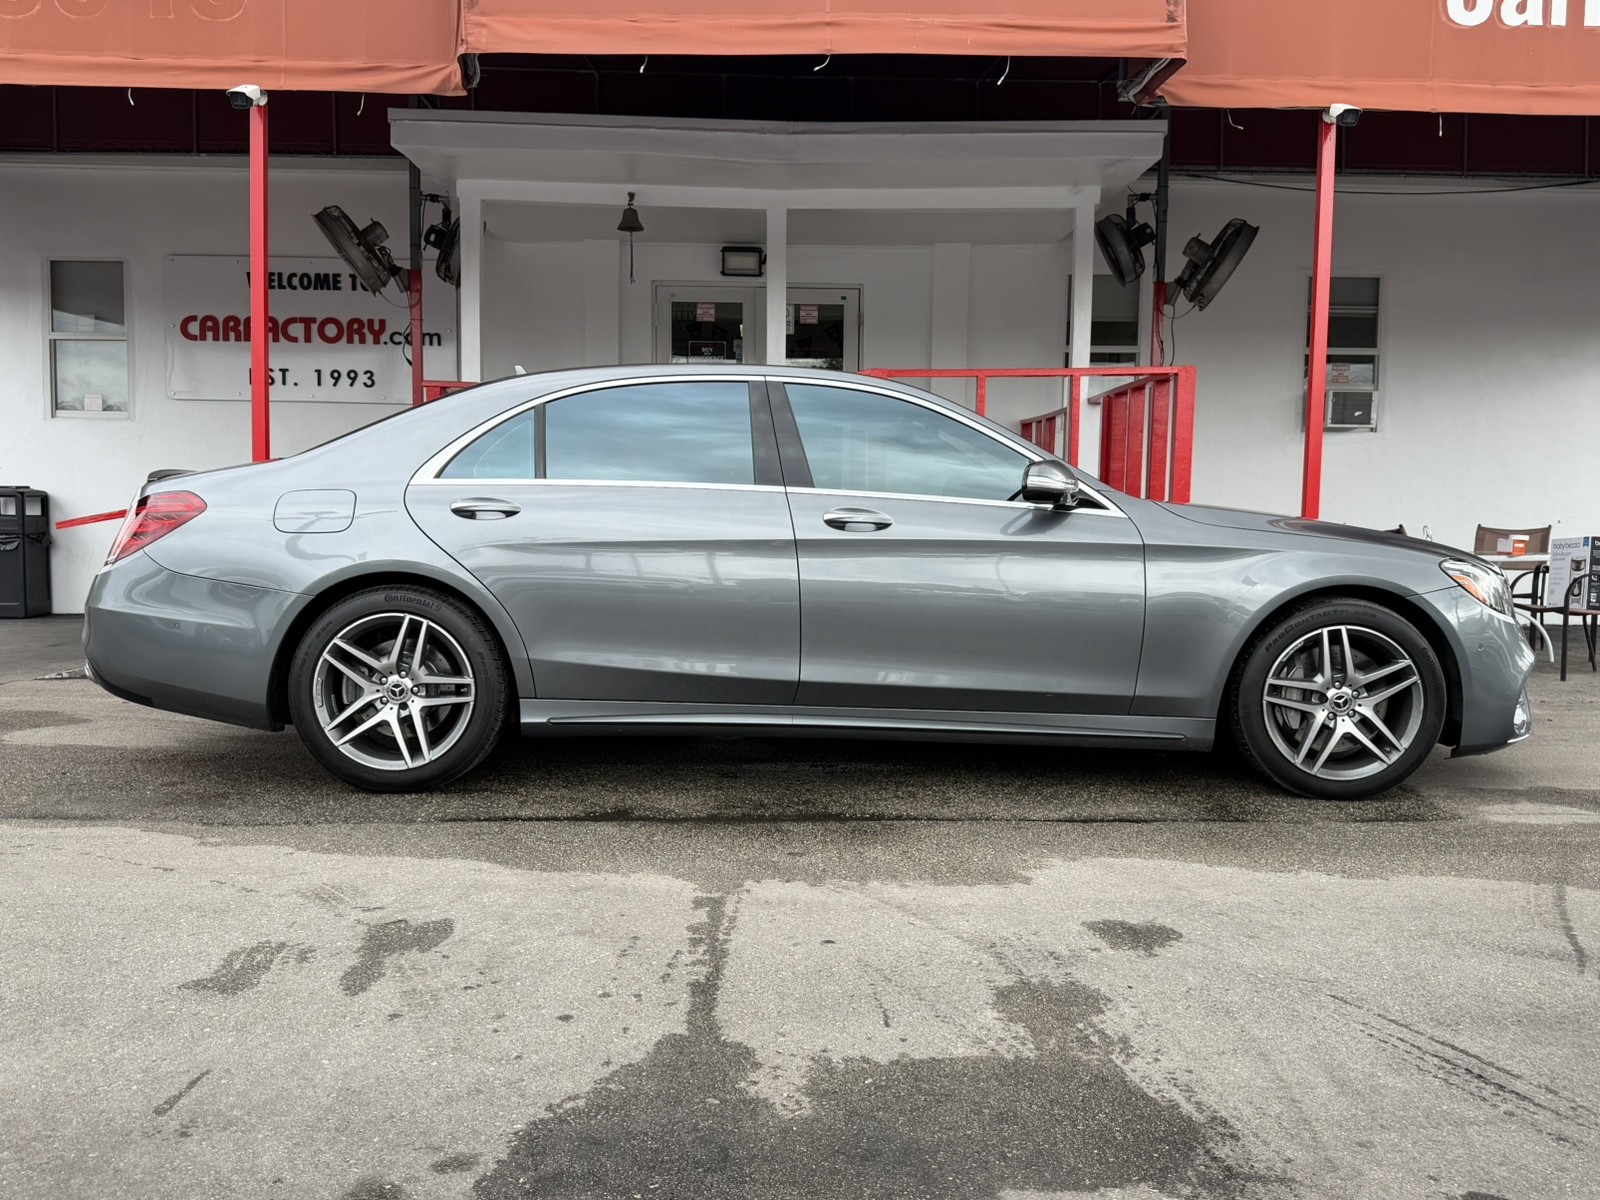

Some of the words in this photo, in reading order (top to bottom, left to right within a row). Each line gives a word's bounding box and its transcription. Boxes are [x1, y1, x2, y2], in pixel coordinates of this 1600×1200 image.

[246, 271, 342, 291] ELCOME
[349, 273, 369, 291] T
[314, 369, 376, 388] 1993
